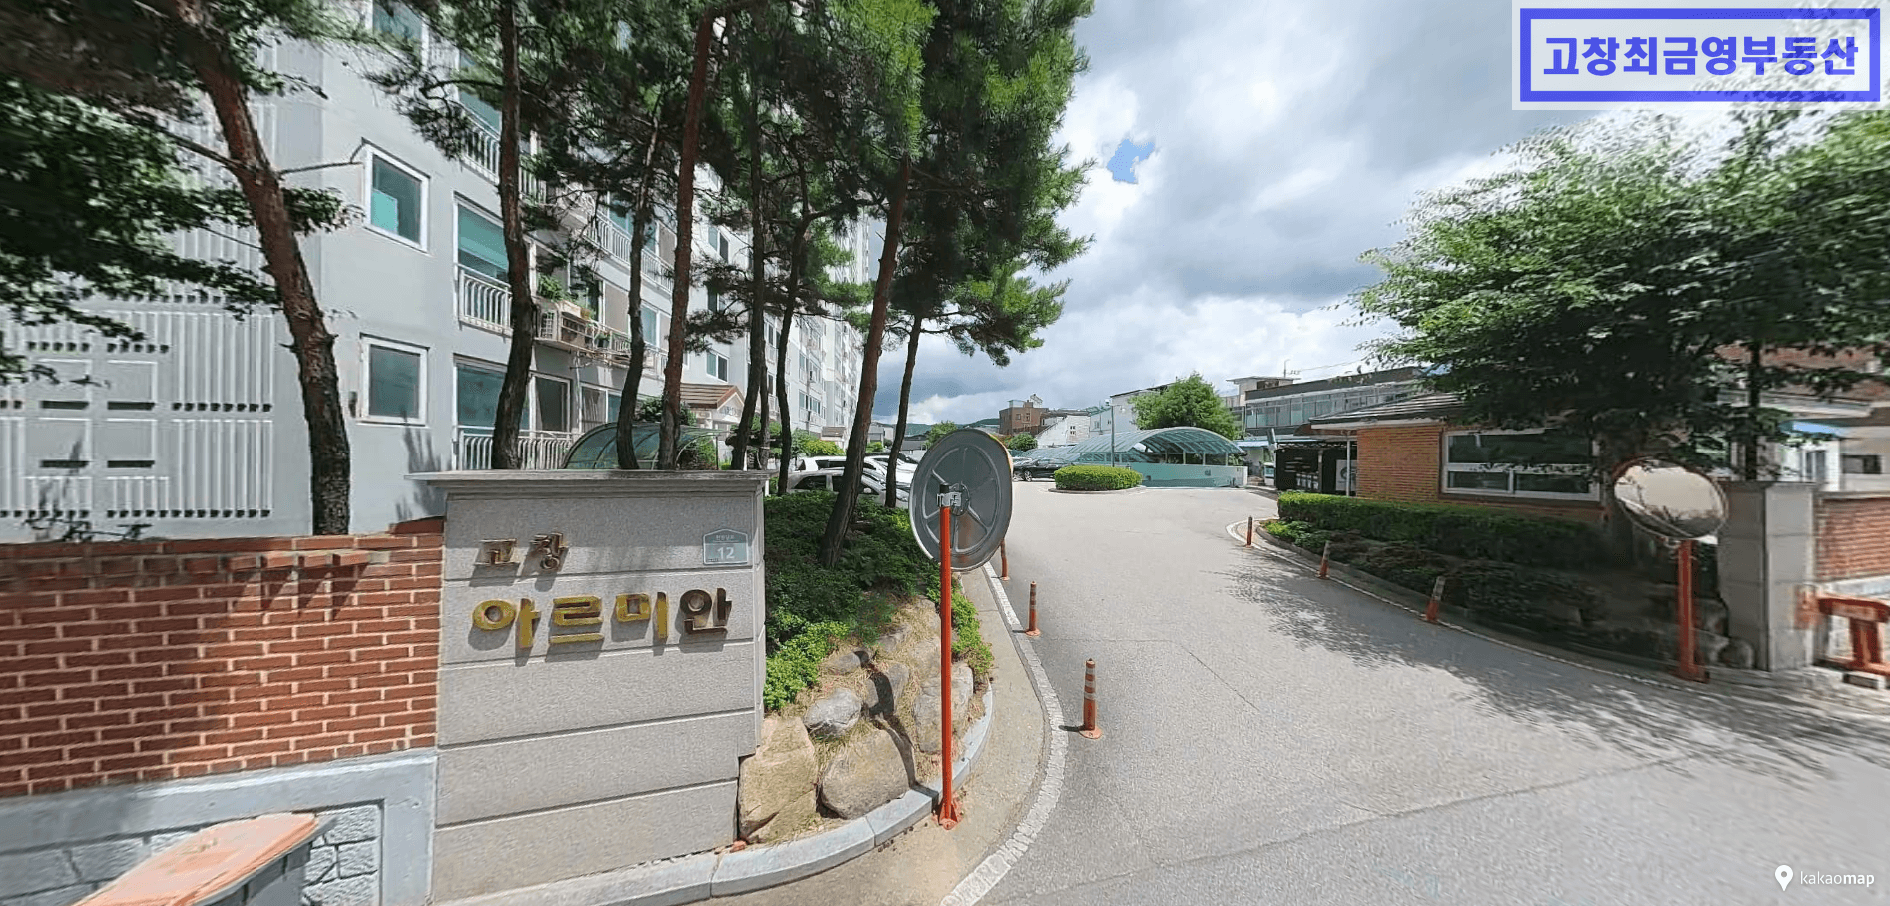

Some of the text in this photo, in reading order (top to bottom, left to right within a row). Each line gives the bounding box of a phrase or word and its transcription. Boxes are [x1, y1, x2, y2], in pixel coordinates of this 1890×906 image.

[474, 532, 568, 571] 고창
[717, 547, 735, 560] 12
[473, 588, 732, 648] 아르미안
